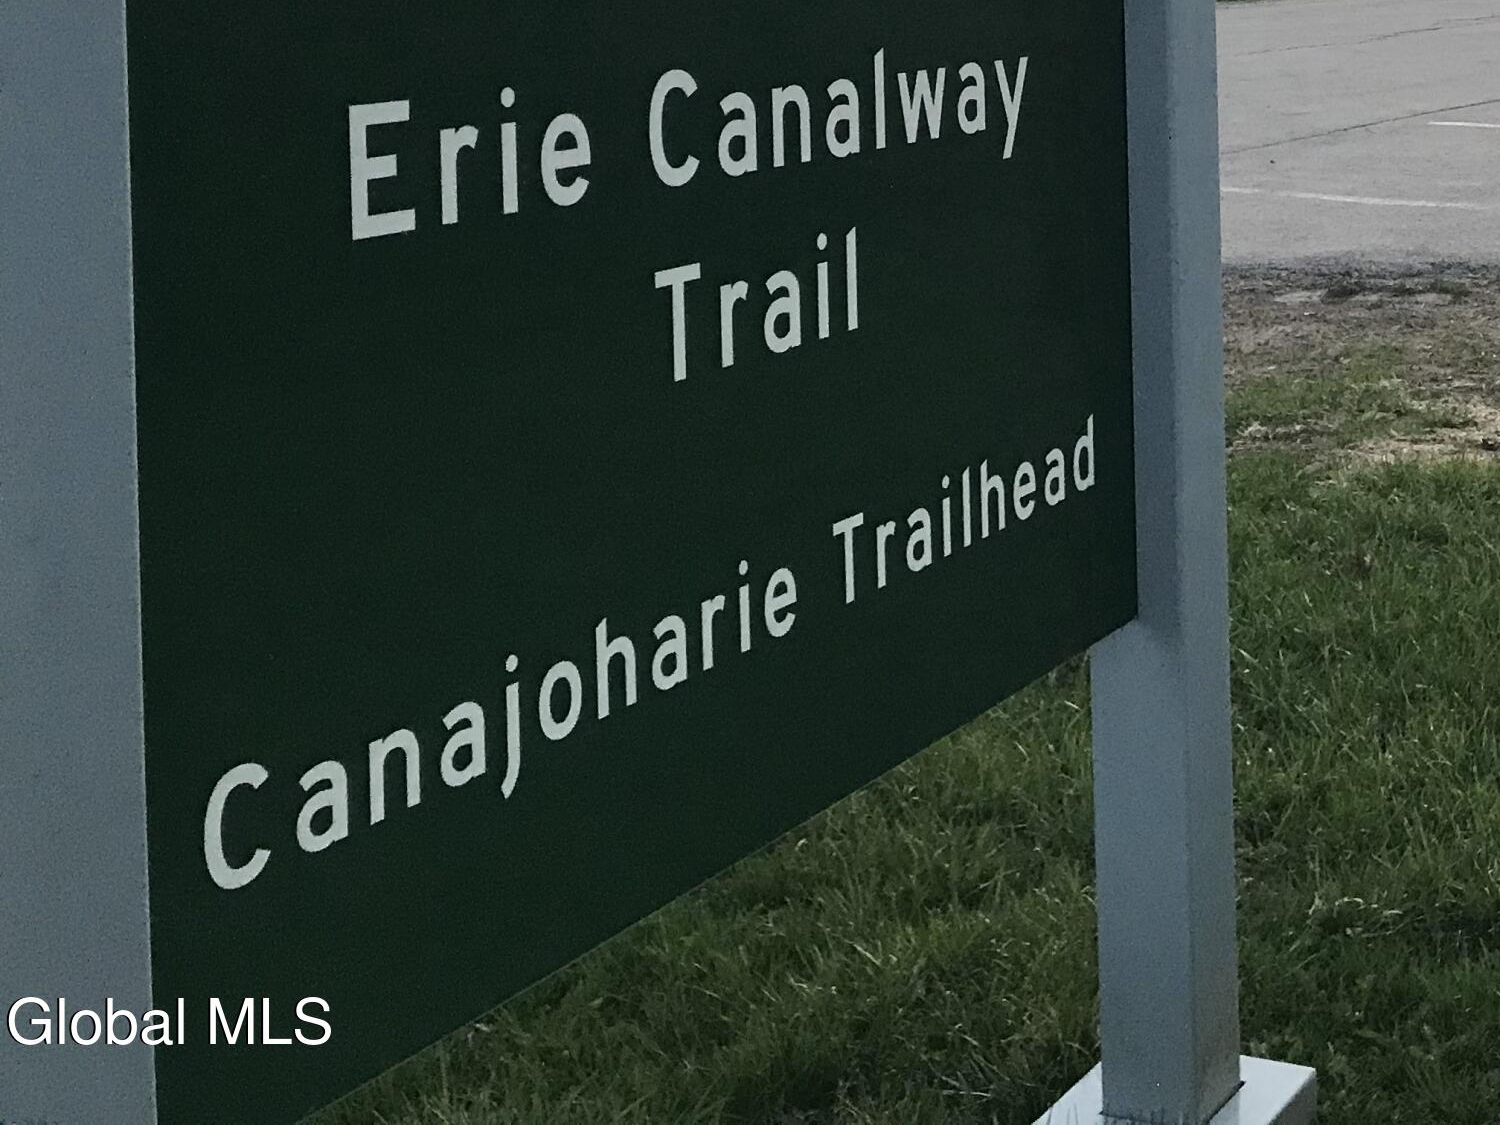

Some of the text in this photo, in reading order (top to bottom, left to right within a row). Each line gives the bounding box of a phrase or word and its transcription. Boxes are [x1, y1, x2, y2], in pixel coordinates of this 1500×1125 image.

[347, 45, 1030, 242] Erie Canalway
[653, 225, 860, 383] Trail
[203, 413, 1096, 891] Canajoharie Trailhead
